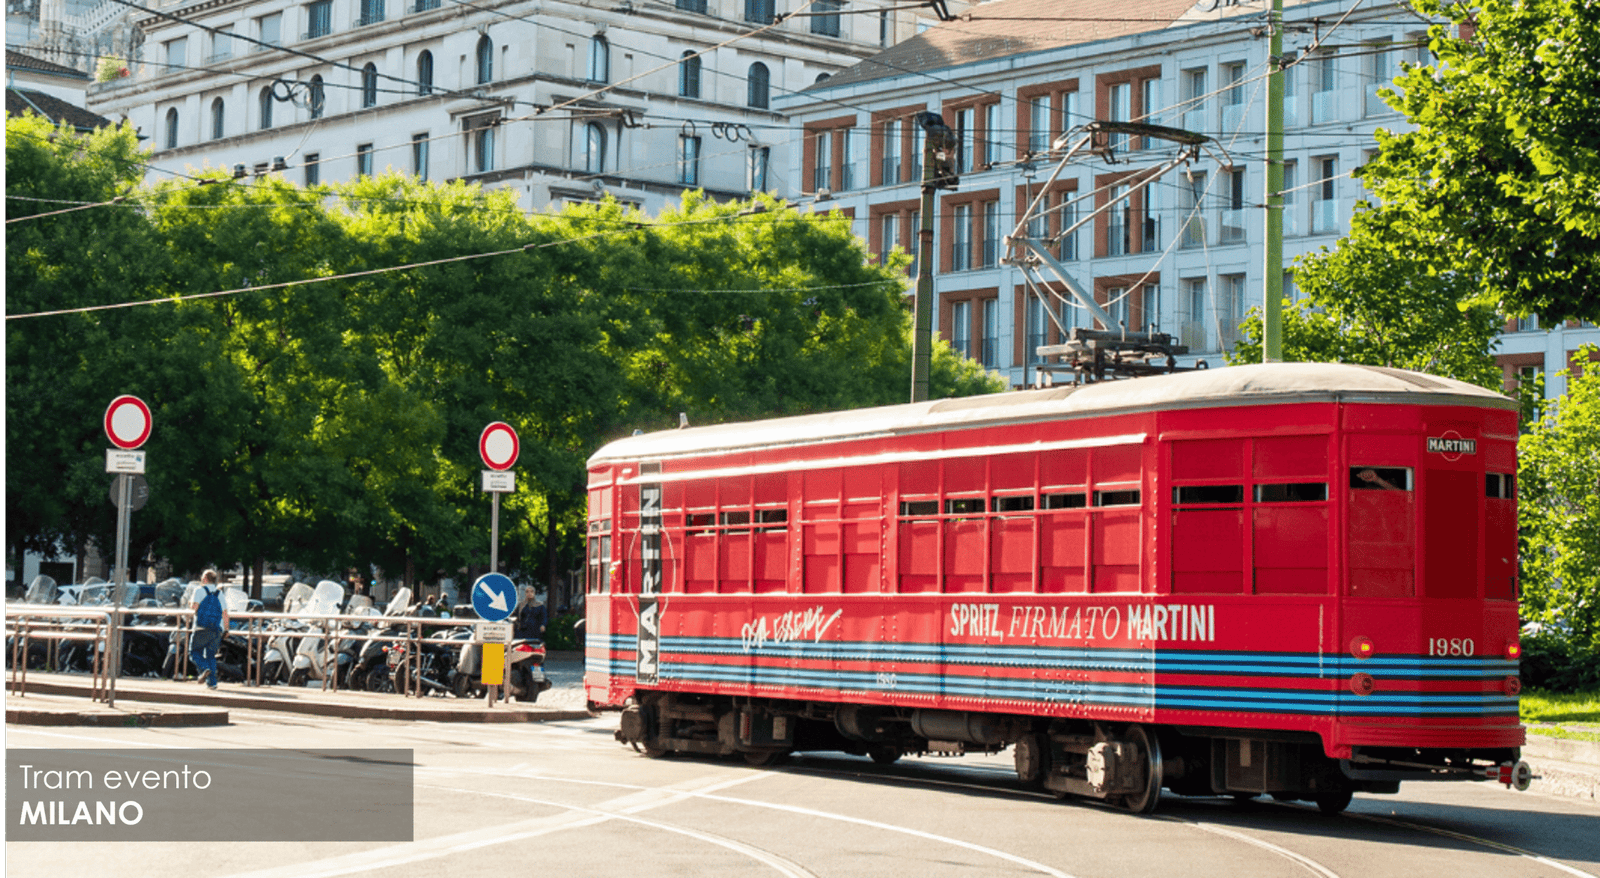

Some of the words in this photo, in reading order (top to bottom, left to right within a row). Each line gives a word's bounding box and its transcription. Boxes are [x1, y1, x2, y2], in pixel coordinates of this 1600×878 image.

[1428, 439, 1475, 453] MARTINI
[950, 603, 1004, 643] SPRITZ,
[1007, 605, 1121, 640] FIRMATO
[1127, 604, 1215, 642] MARTINI
[1428, 637, 1475, 657] 1980
